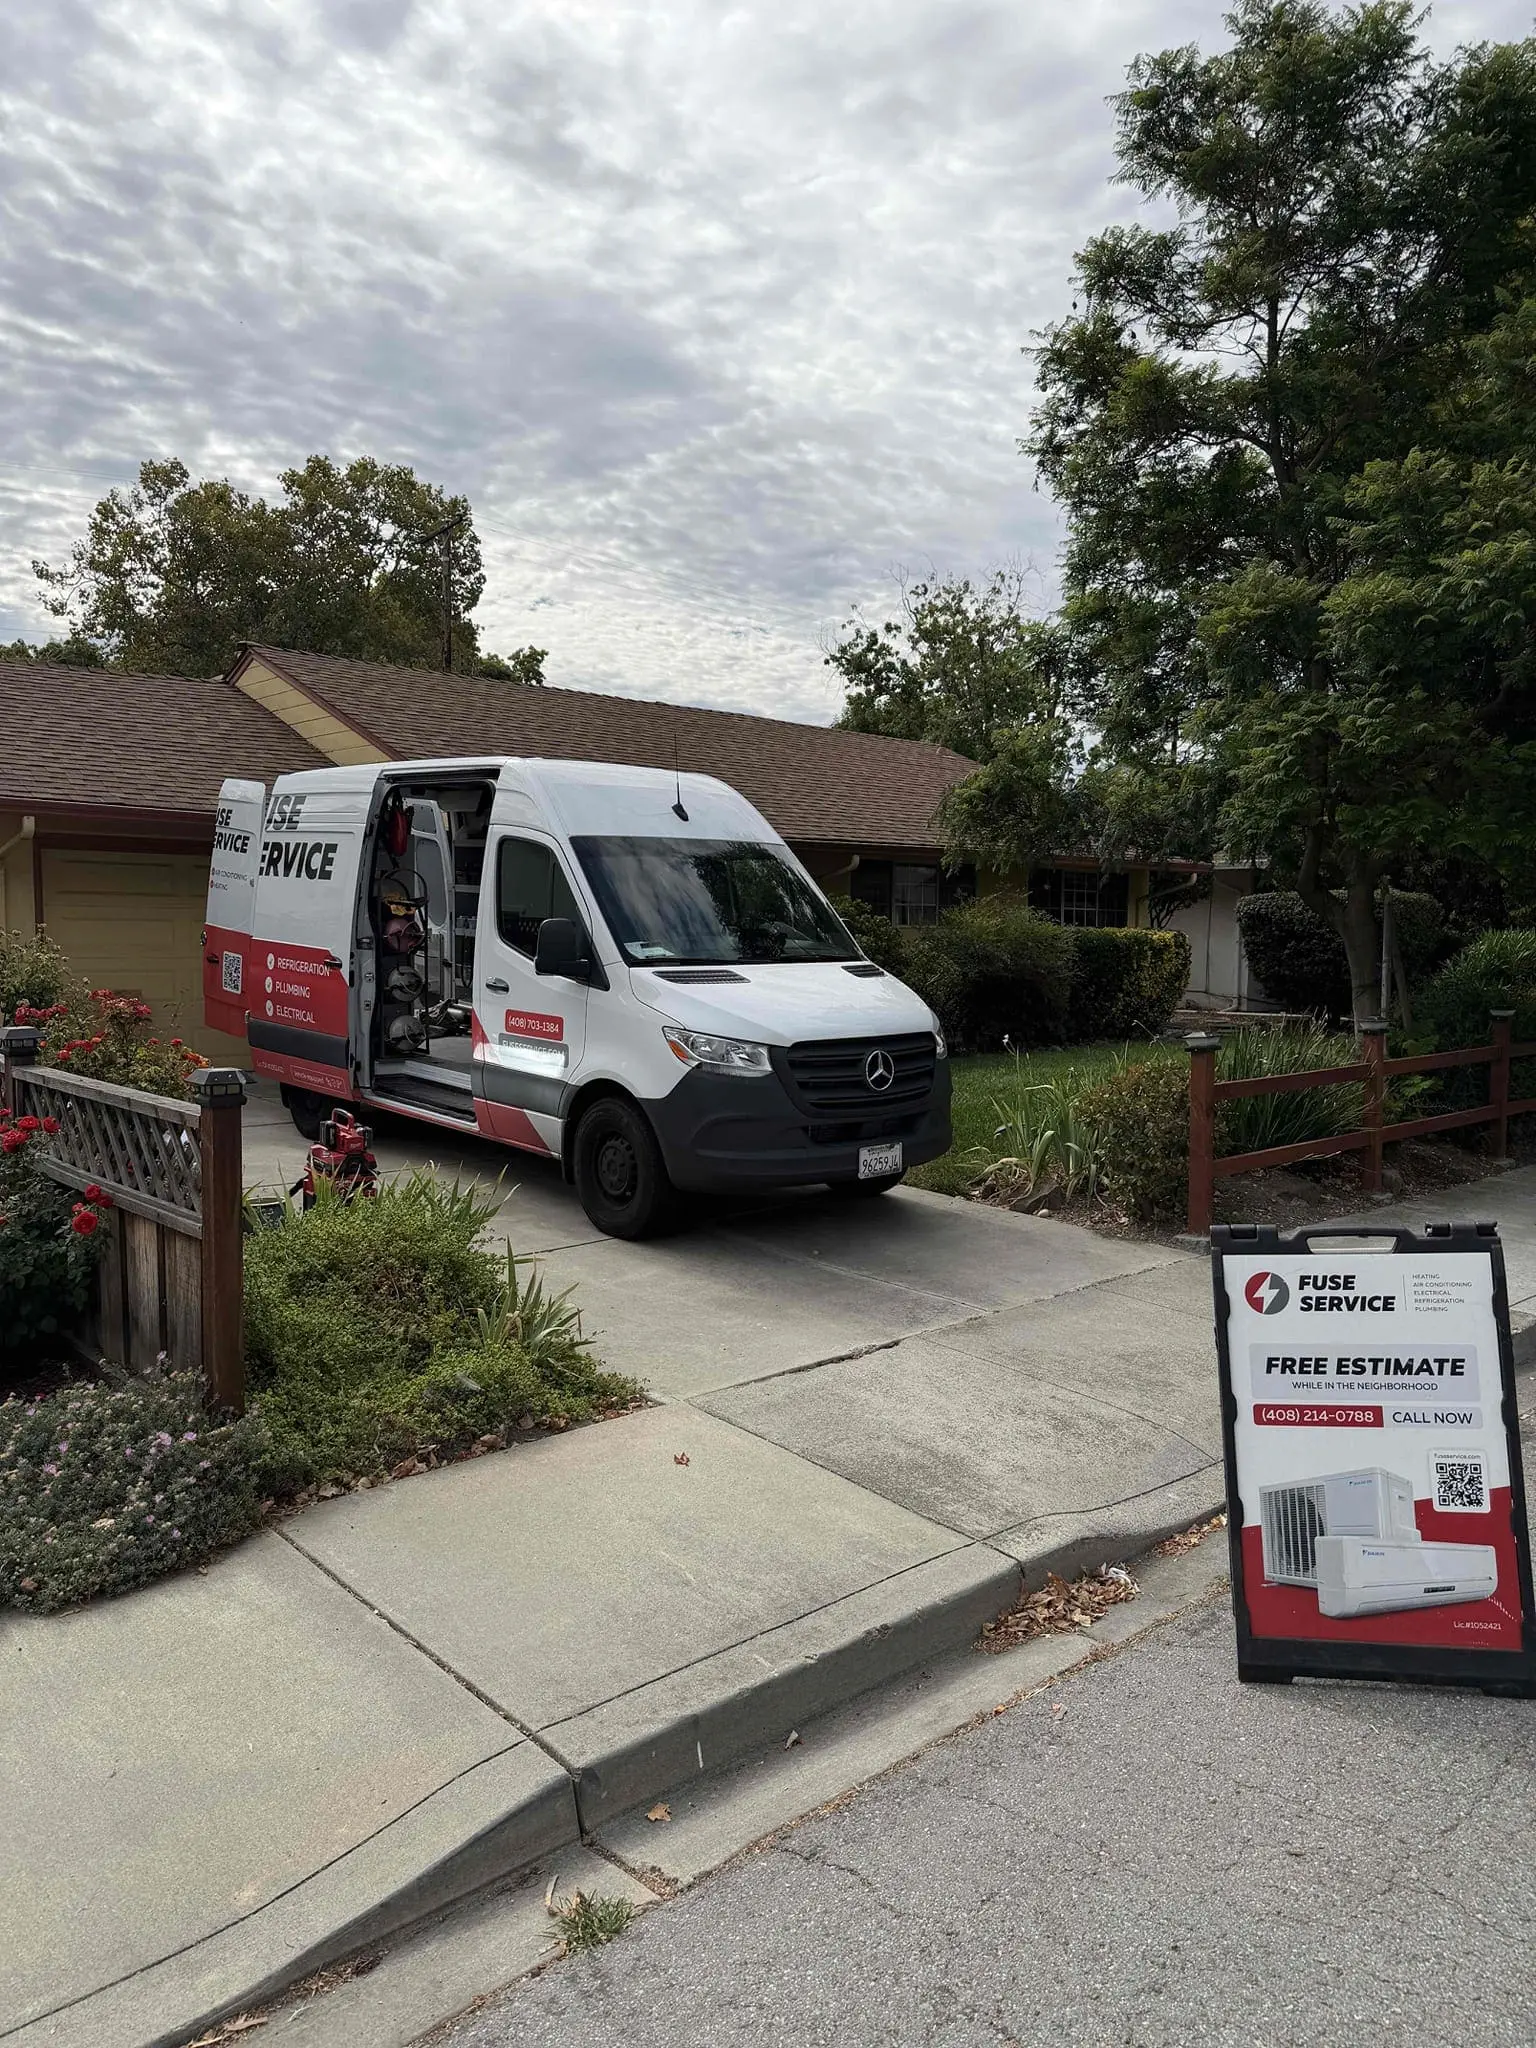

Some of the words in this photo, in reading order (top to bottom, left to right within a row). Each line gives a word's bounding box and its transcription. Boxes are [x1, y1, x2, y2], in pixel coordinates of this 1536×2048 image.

[277, 957, 330, 976] REFRIGERATION
[275, 981, 310, 998] PLUMBING
[276, 1005, 316, 1023] ELECTRICAL
[509, 1016, 526, 1029] (408)
[527, 1019, 559, 1033] 703-1384
[1298, 1274, 1356, 1291] FUSE
[1299, 1295, 1396, 1312] SERVICE
[1265, 1356, 1328, 1375] FREE
[1335, 1357, 1466, 1377] ESTIMATE
[1292, 1381, 1322, 1390] WHILE
[1324, 1381, 1334, 1390] IN
[1336, 1382, 1354, 1390] THE
[1357, 1382, 1438, 1391] NEIGHBORHOOD
[1261, 1408, 1300, 1422] (408)
[1303, 1409, 1374, 1423] 214-0788
[1392, 1411, 1431, 1424] CALL
[1434, 1412, 1473, 1425] NOW
